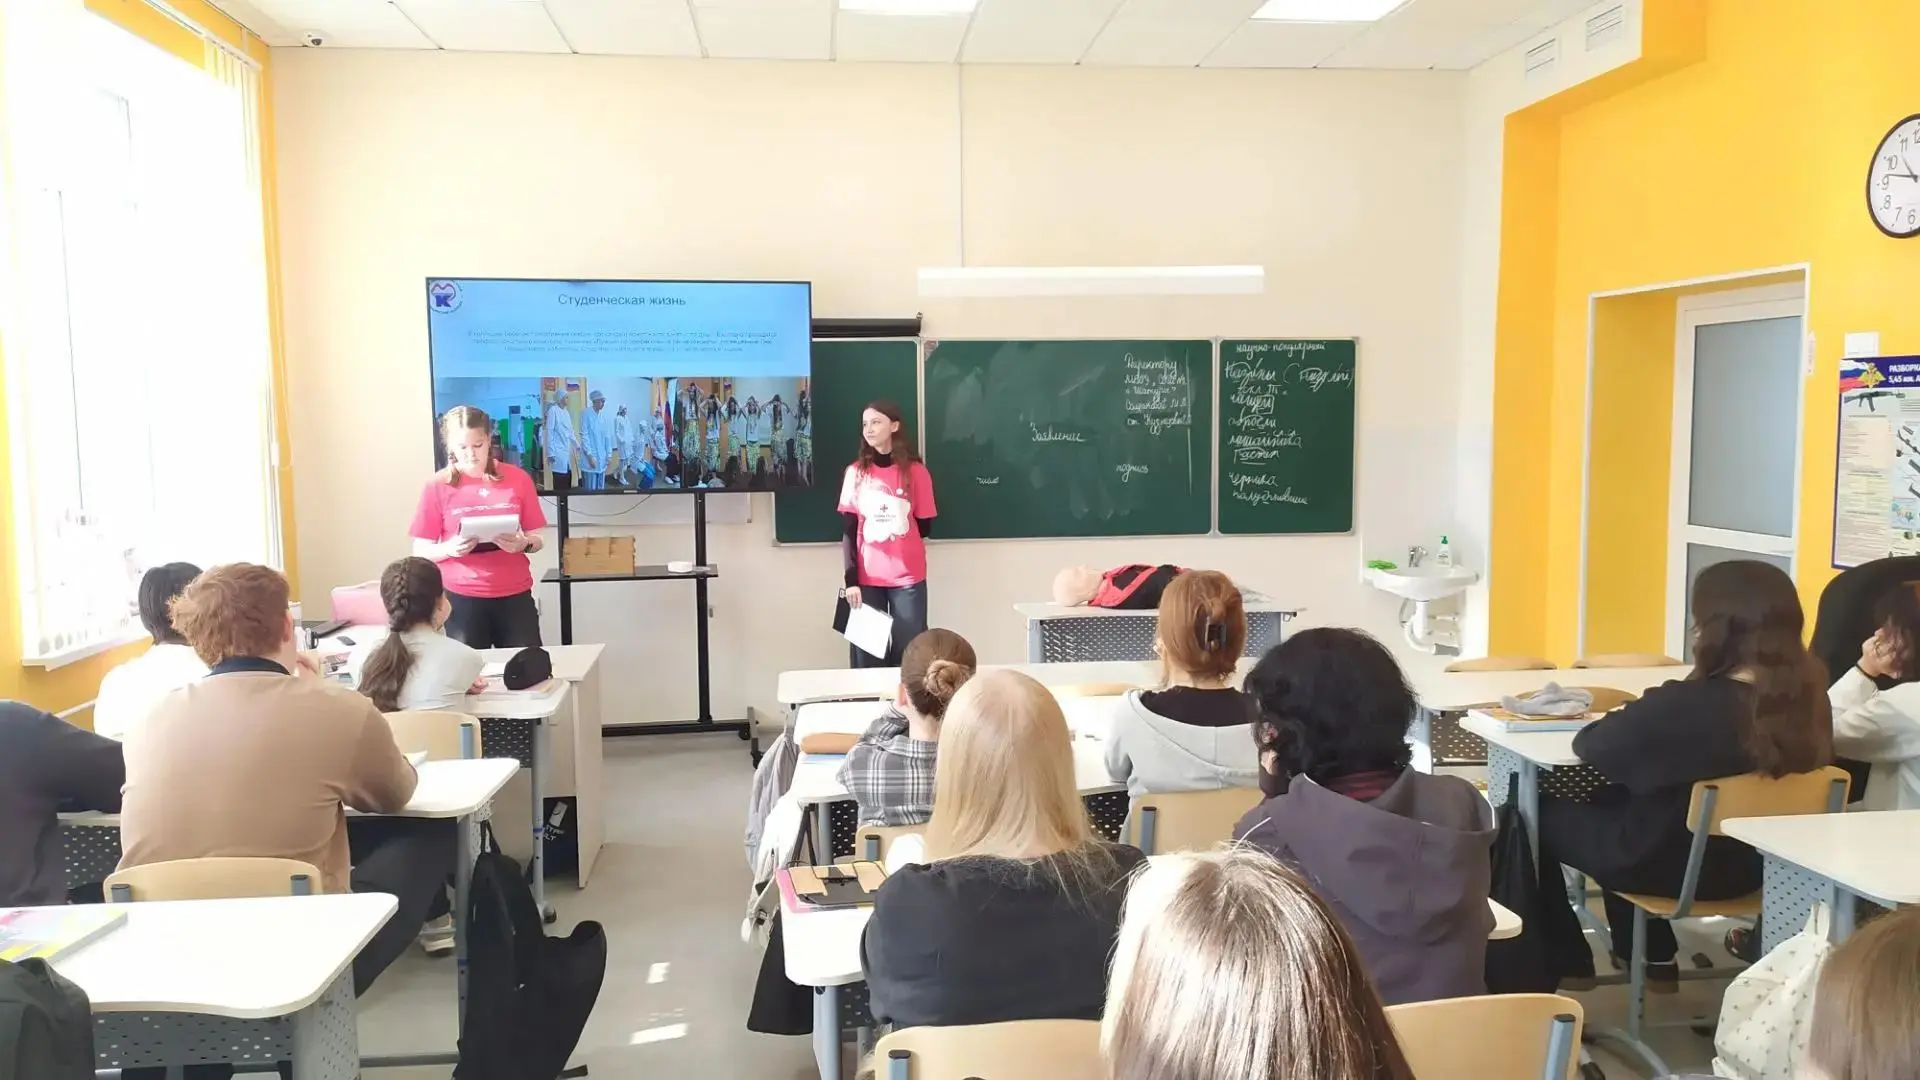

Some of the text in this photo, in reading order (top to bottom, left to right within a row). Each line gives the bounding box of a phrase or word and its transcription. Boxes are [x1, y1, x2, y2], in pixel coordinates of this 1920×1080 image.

[1899, 136, 1908, 153] 11
[1887, 154, 1898, 171] 10
[1881, 174, 1890, 191] 9
[1883, 194, 1892, 210] 8
[1895, 206, 1902, 221] 7
[1907, 208, 1916, 225] 6
[558, 293, 687, 307] Студенческая жизнь
